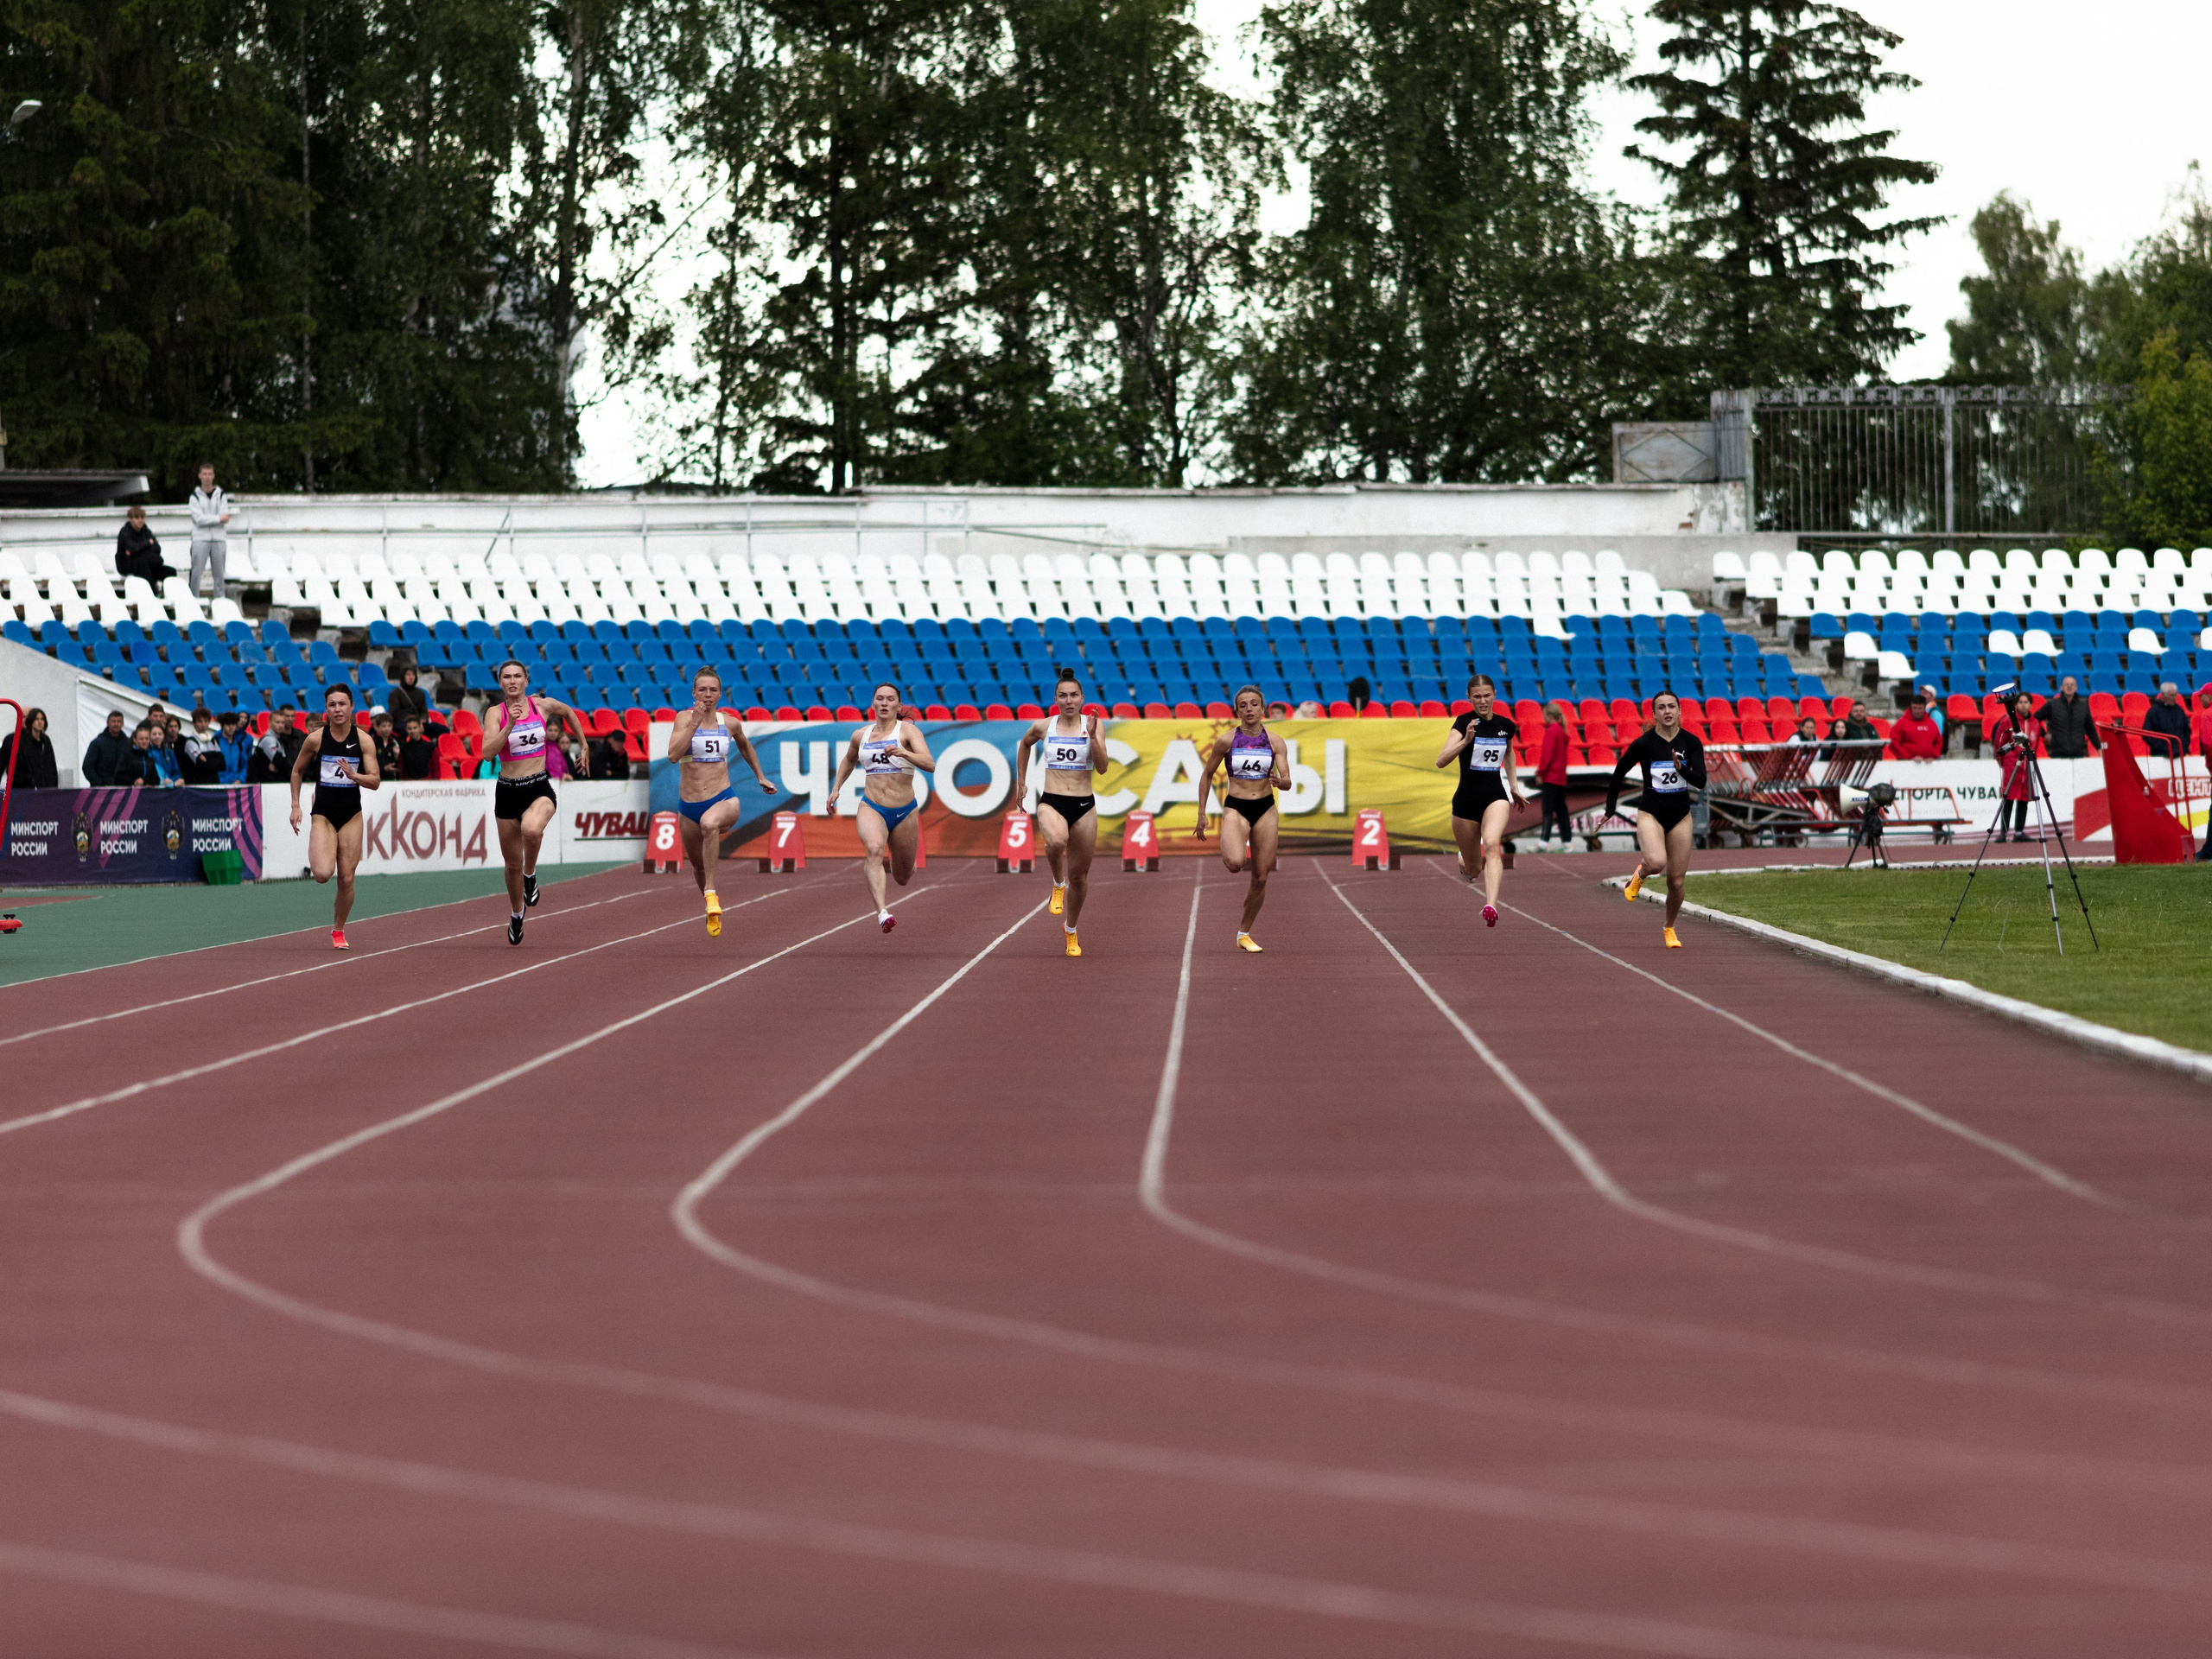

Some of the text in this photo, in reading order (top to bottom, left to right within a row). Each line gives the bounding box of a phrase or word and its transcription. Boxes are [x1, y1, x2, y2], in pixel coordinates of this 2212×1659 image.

[518, 734, 537, 747] 36
[705, 741, 720, 753] 51
[872, 753, 890, 764] 48
[1057, 748, 1077, 761] 50
[1484, 750, 1499, 762] 95
[1242, 760, 1262, 772] 46
[1662, 772, 1678, 785] 26
[402, 787, 486, 798] КОНДИТЕРСКАЯ ФАБРИКА
[10, 821, 59, 836] МИНСПОРТ
[99, 820, 148, 835] МИНСПОРТ
[192, 817, 243, 833] МИНСПОРТ
[359, 791, 487, 867] ККОНД
[1361, 819, 1381, 845] 2
[656, 823, 676, 850] 8
[777, 822, 796, 848] 7
[1007, 822, 1027, 848] 5
[1130, 821, 1150, 848] 4
[11, 842, 48, 856] РОССИИ
[100, 840, 137, 855] РОССИИ
[192, 837, 232, 852] РОССИИ
